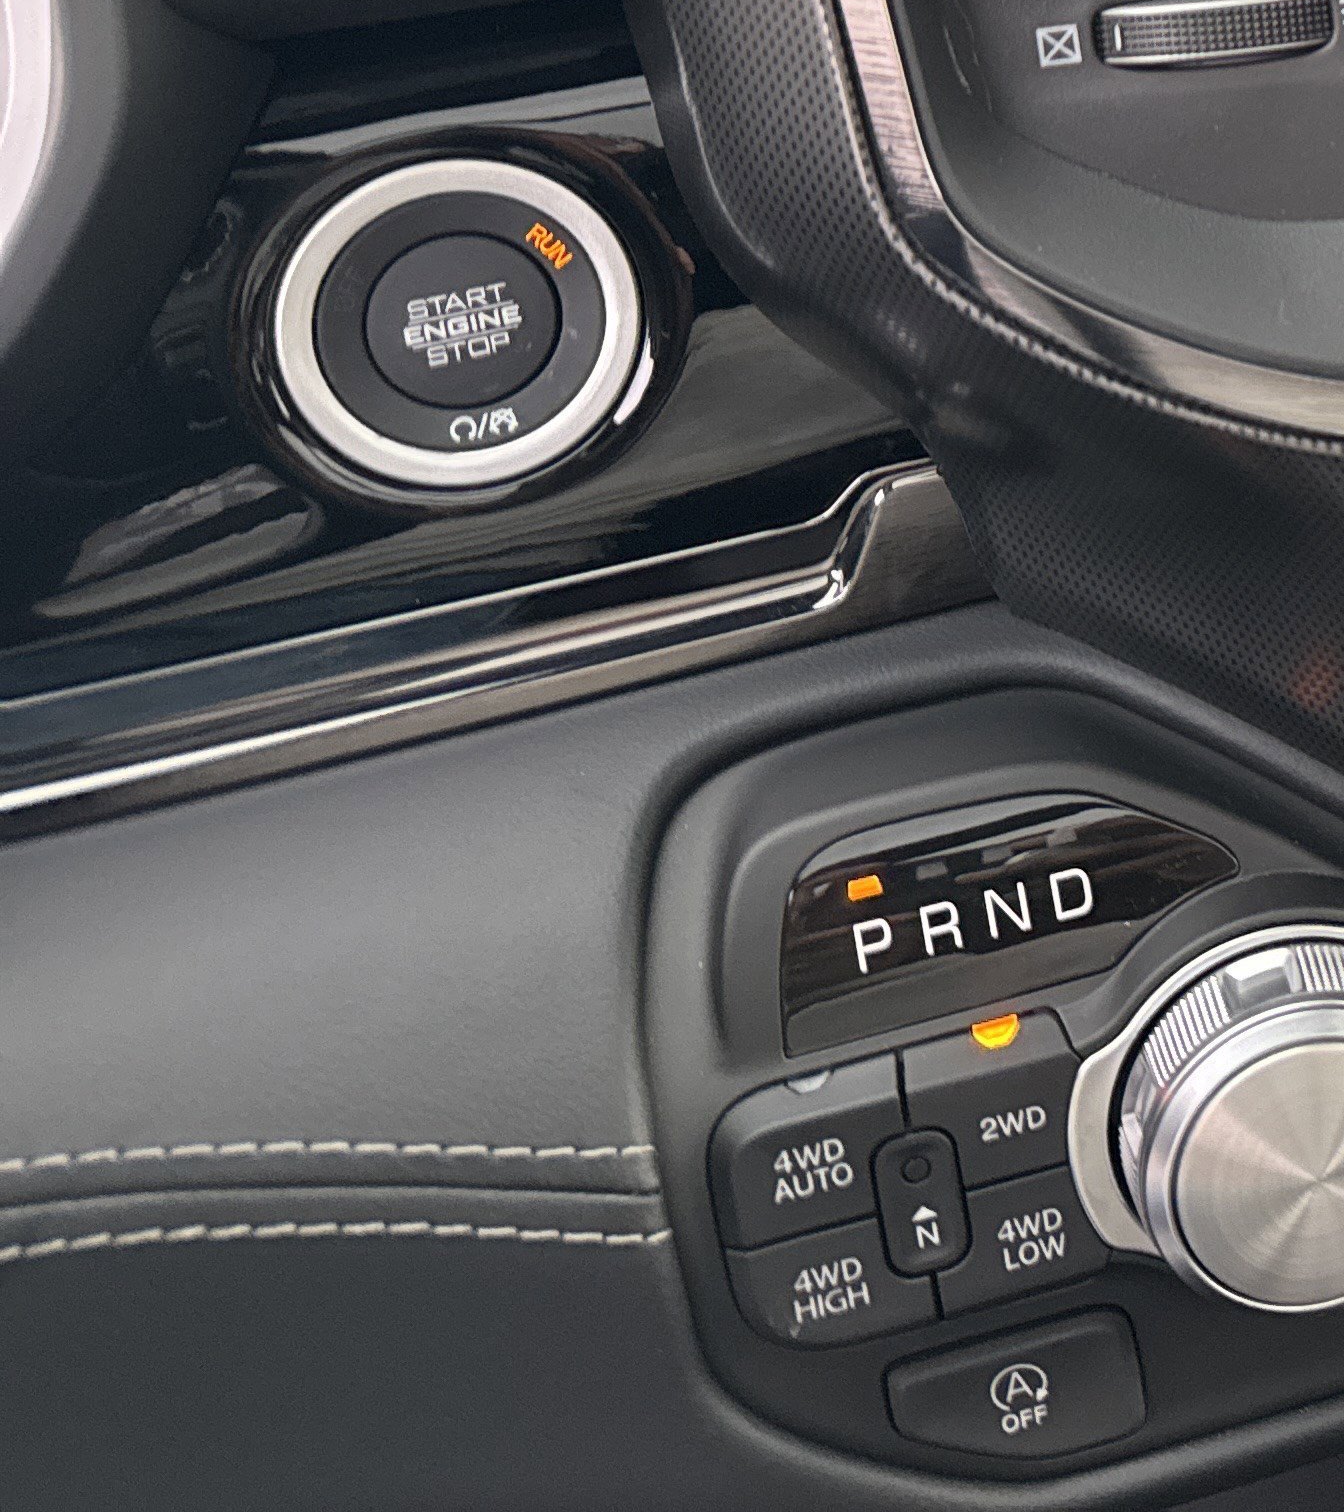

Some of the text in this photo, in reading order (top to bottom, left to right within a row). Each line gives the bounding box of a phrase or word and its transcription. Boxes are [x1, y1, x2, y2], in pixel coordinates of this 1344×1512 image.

[525, 222, 574, 270] RUN
[407, 282, 506, 320] START
[403, 303, 523, 346] ENGINE
[427, 331, 511, 369] STOP
[852, 867, 1094, 974] P R N D
[979, 1105, 1047, 1144] 2WD
[773, 1136, 845, 1175] 4WD
[773, 1161, 854, 1206] AUTO
[919, 1221, 941, 1248] N
[997, 1207, 1063, 1245] 4WD
[1003, 1231, 1067, 1272] LOW
[793, 1255, 862, 1295] 4WD
[793, 1281, 870, 1324] HIGH
[1001, 1403, 1048, 1435] OFF
